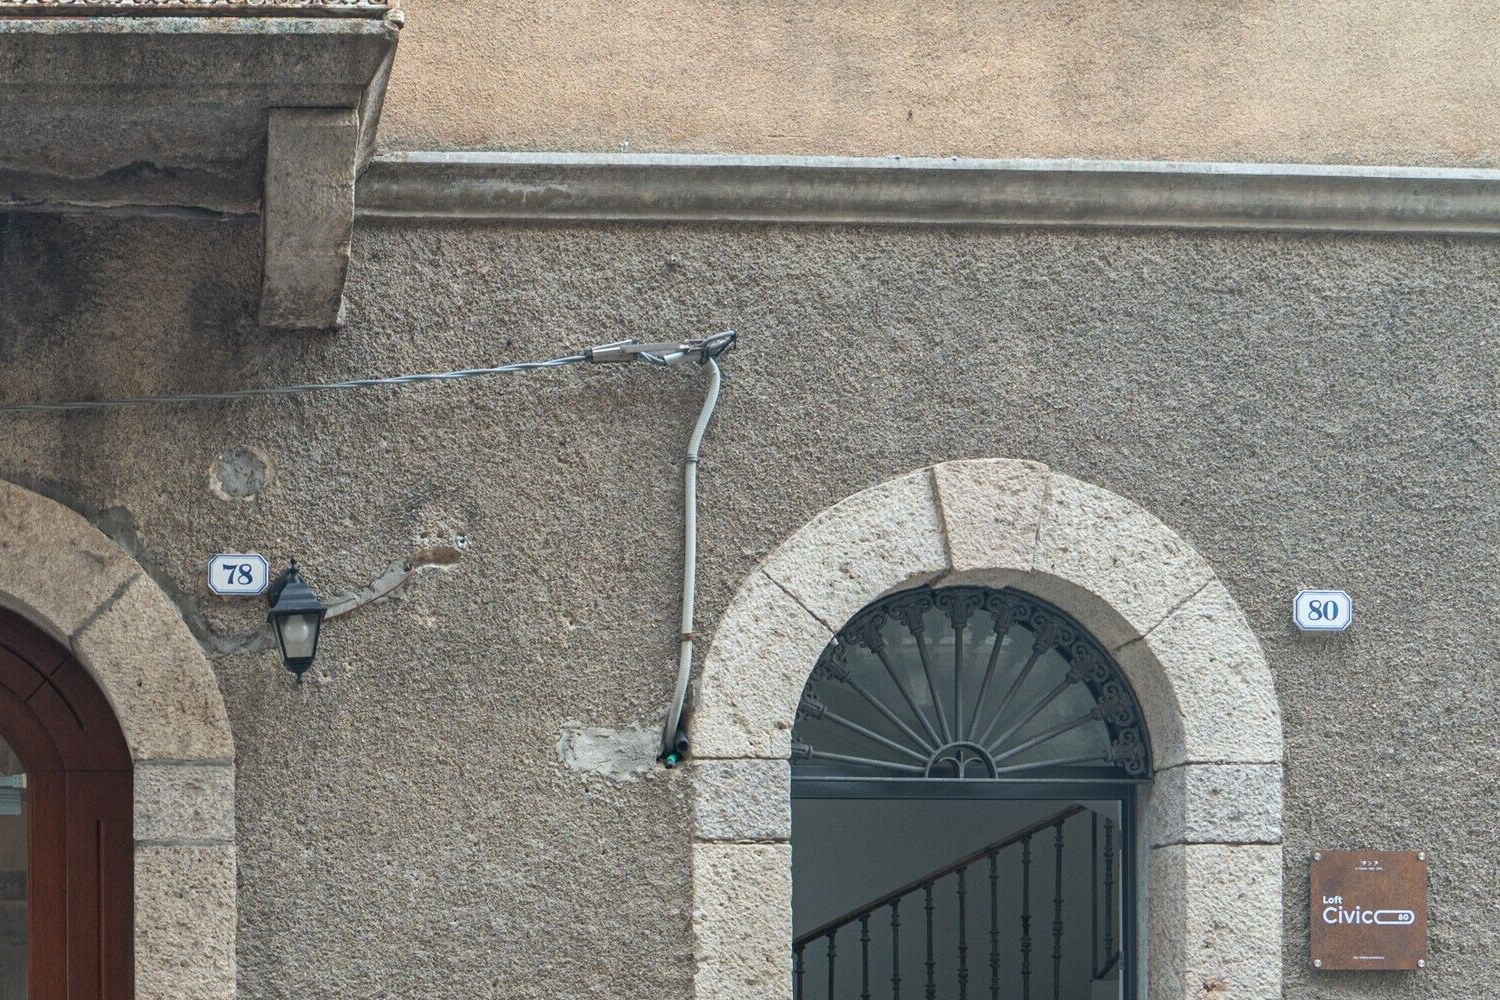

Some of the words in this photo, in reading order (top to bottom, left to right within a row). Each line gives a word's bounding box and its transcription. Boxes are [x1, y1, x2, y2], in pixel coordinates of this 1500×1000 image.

[222, 563, 253, 585] 78
[1308, 599, 1339, 621] 80
[1322, 895, 1343, 905] Loft
[1322, 905, 1374, 925] Civic
[1398, 913, 1410, 921] 80
